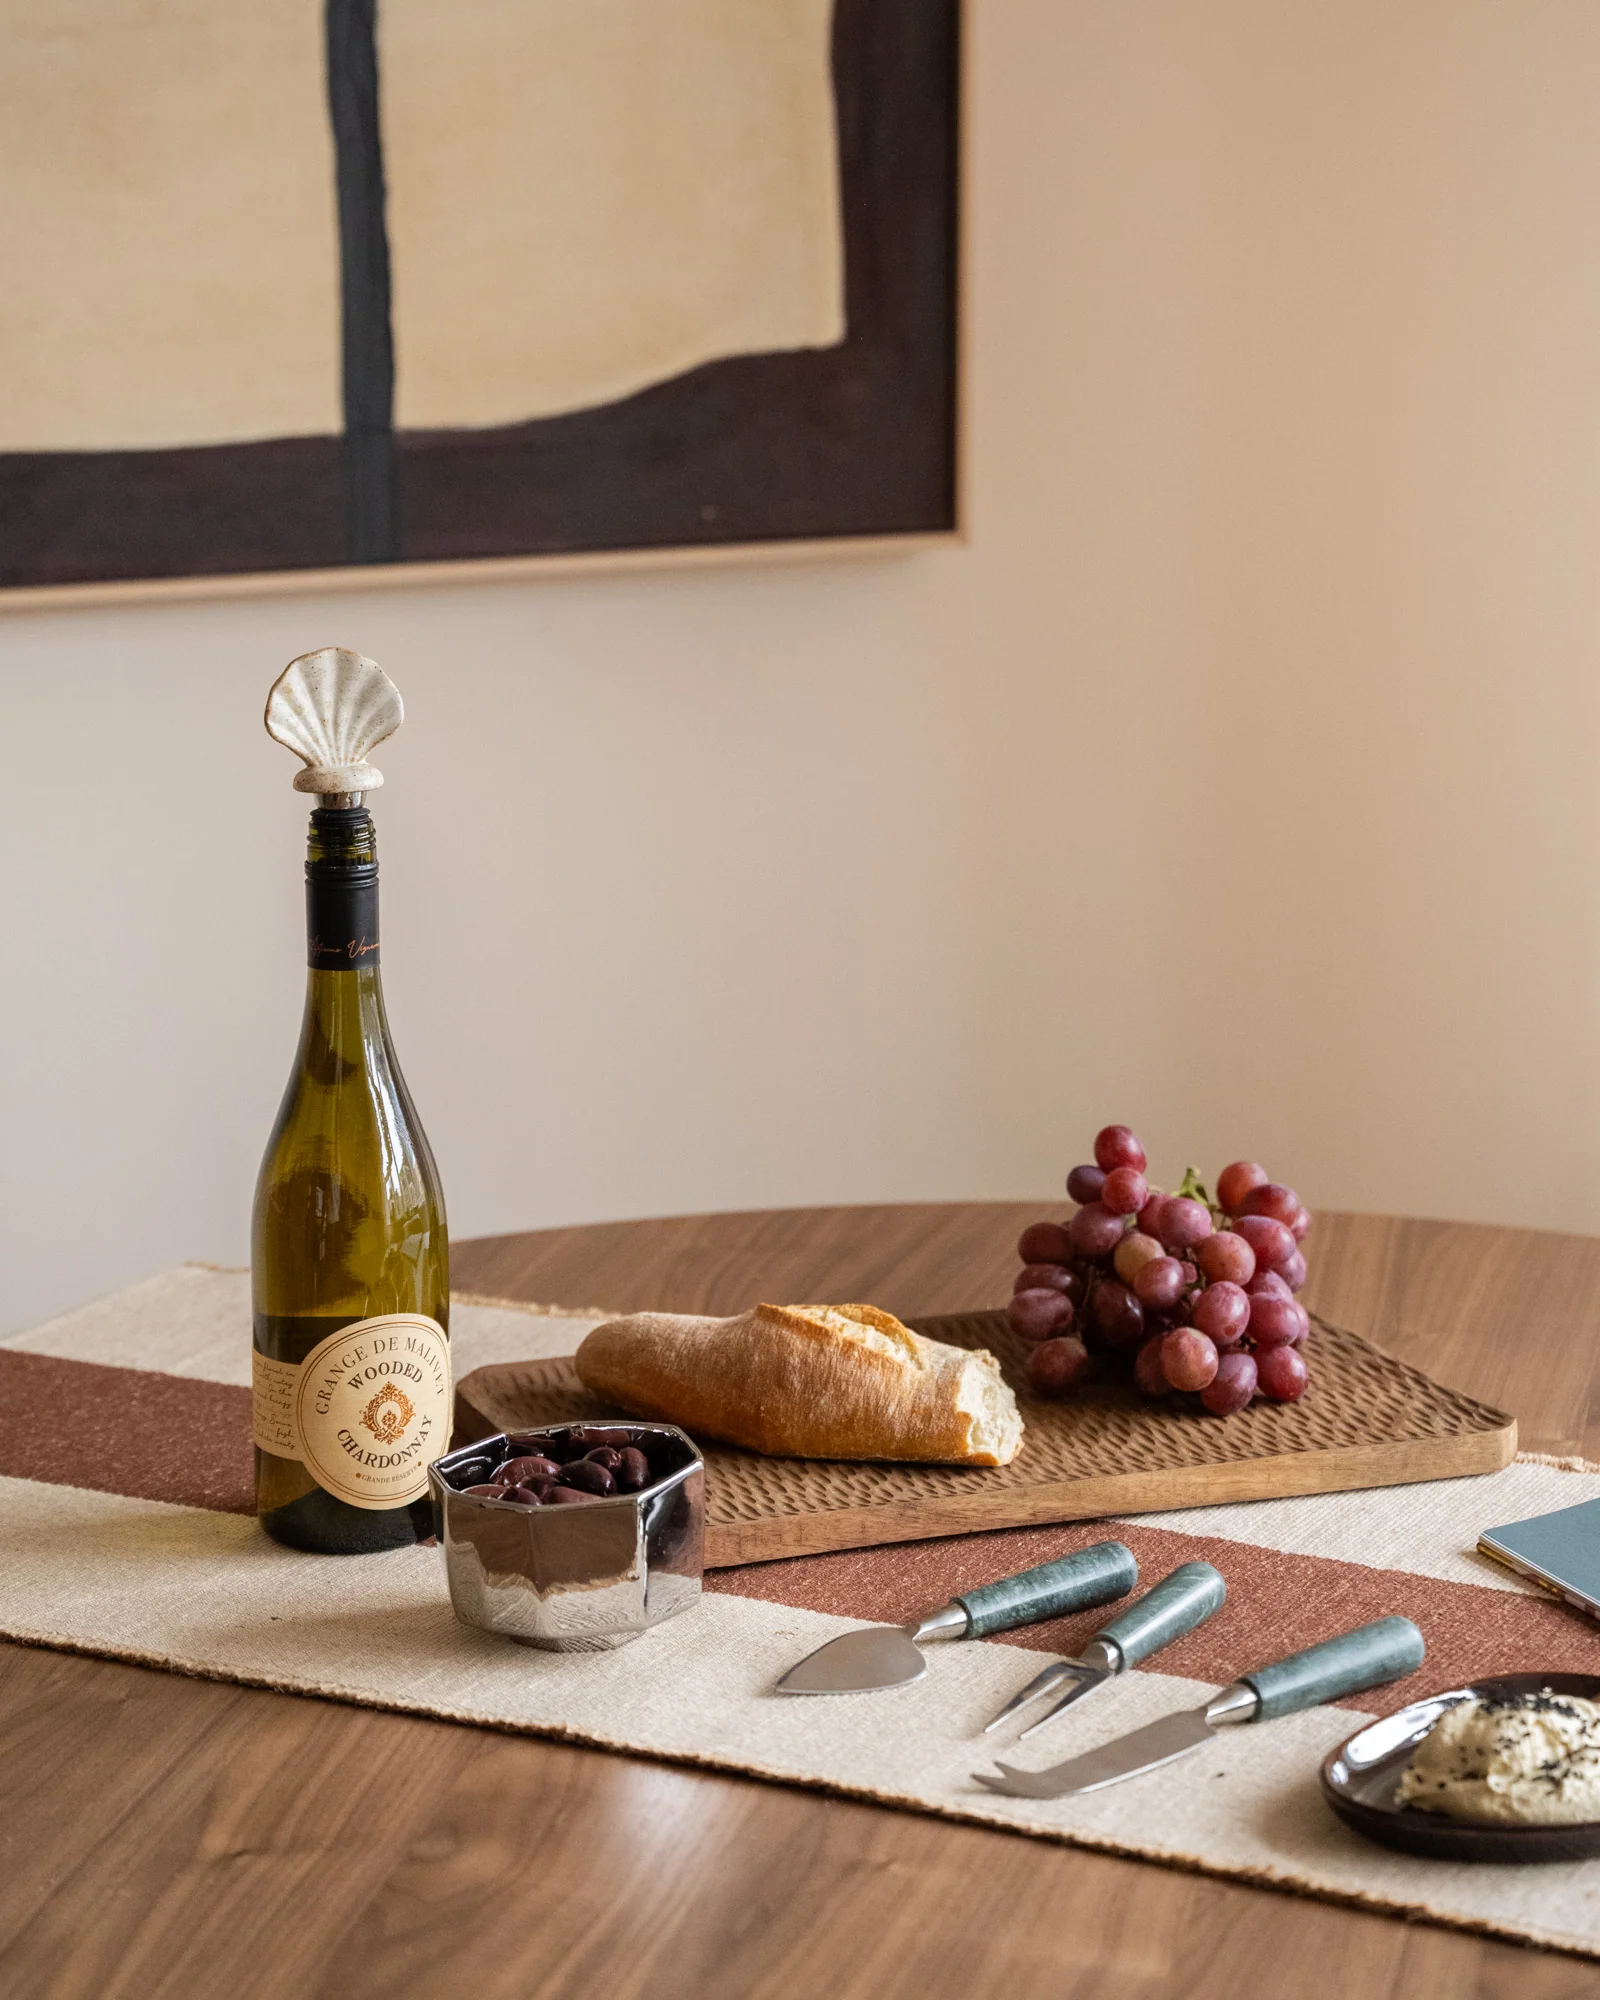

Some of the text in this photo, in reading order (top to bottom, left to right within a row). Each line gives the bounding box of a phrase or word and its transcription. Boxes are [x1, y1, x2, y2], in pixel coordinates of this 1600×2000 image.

[315, 1345, 369, 1416] GRANGE
[373, 1336, 399, 1355] DE
[346, 1360, 424, 1391] WOODED
[337, 1414, 433, 1470] CHARDONNAY
[361, 1466, 419, 1484] GRANDE RESERVE
